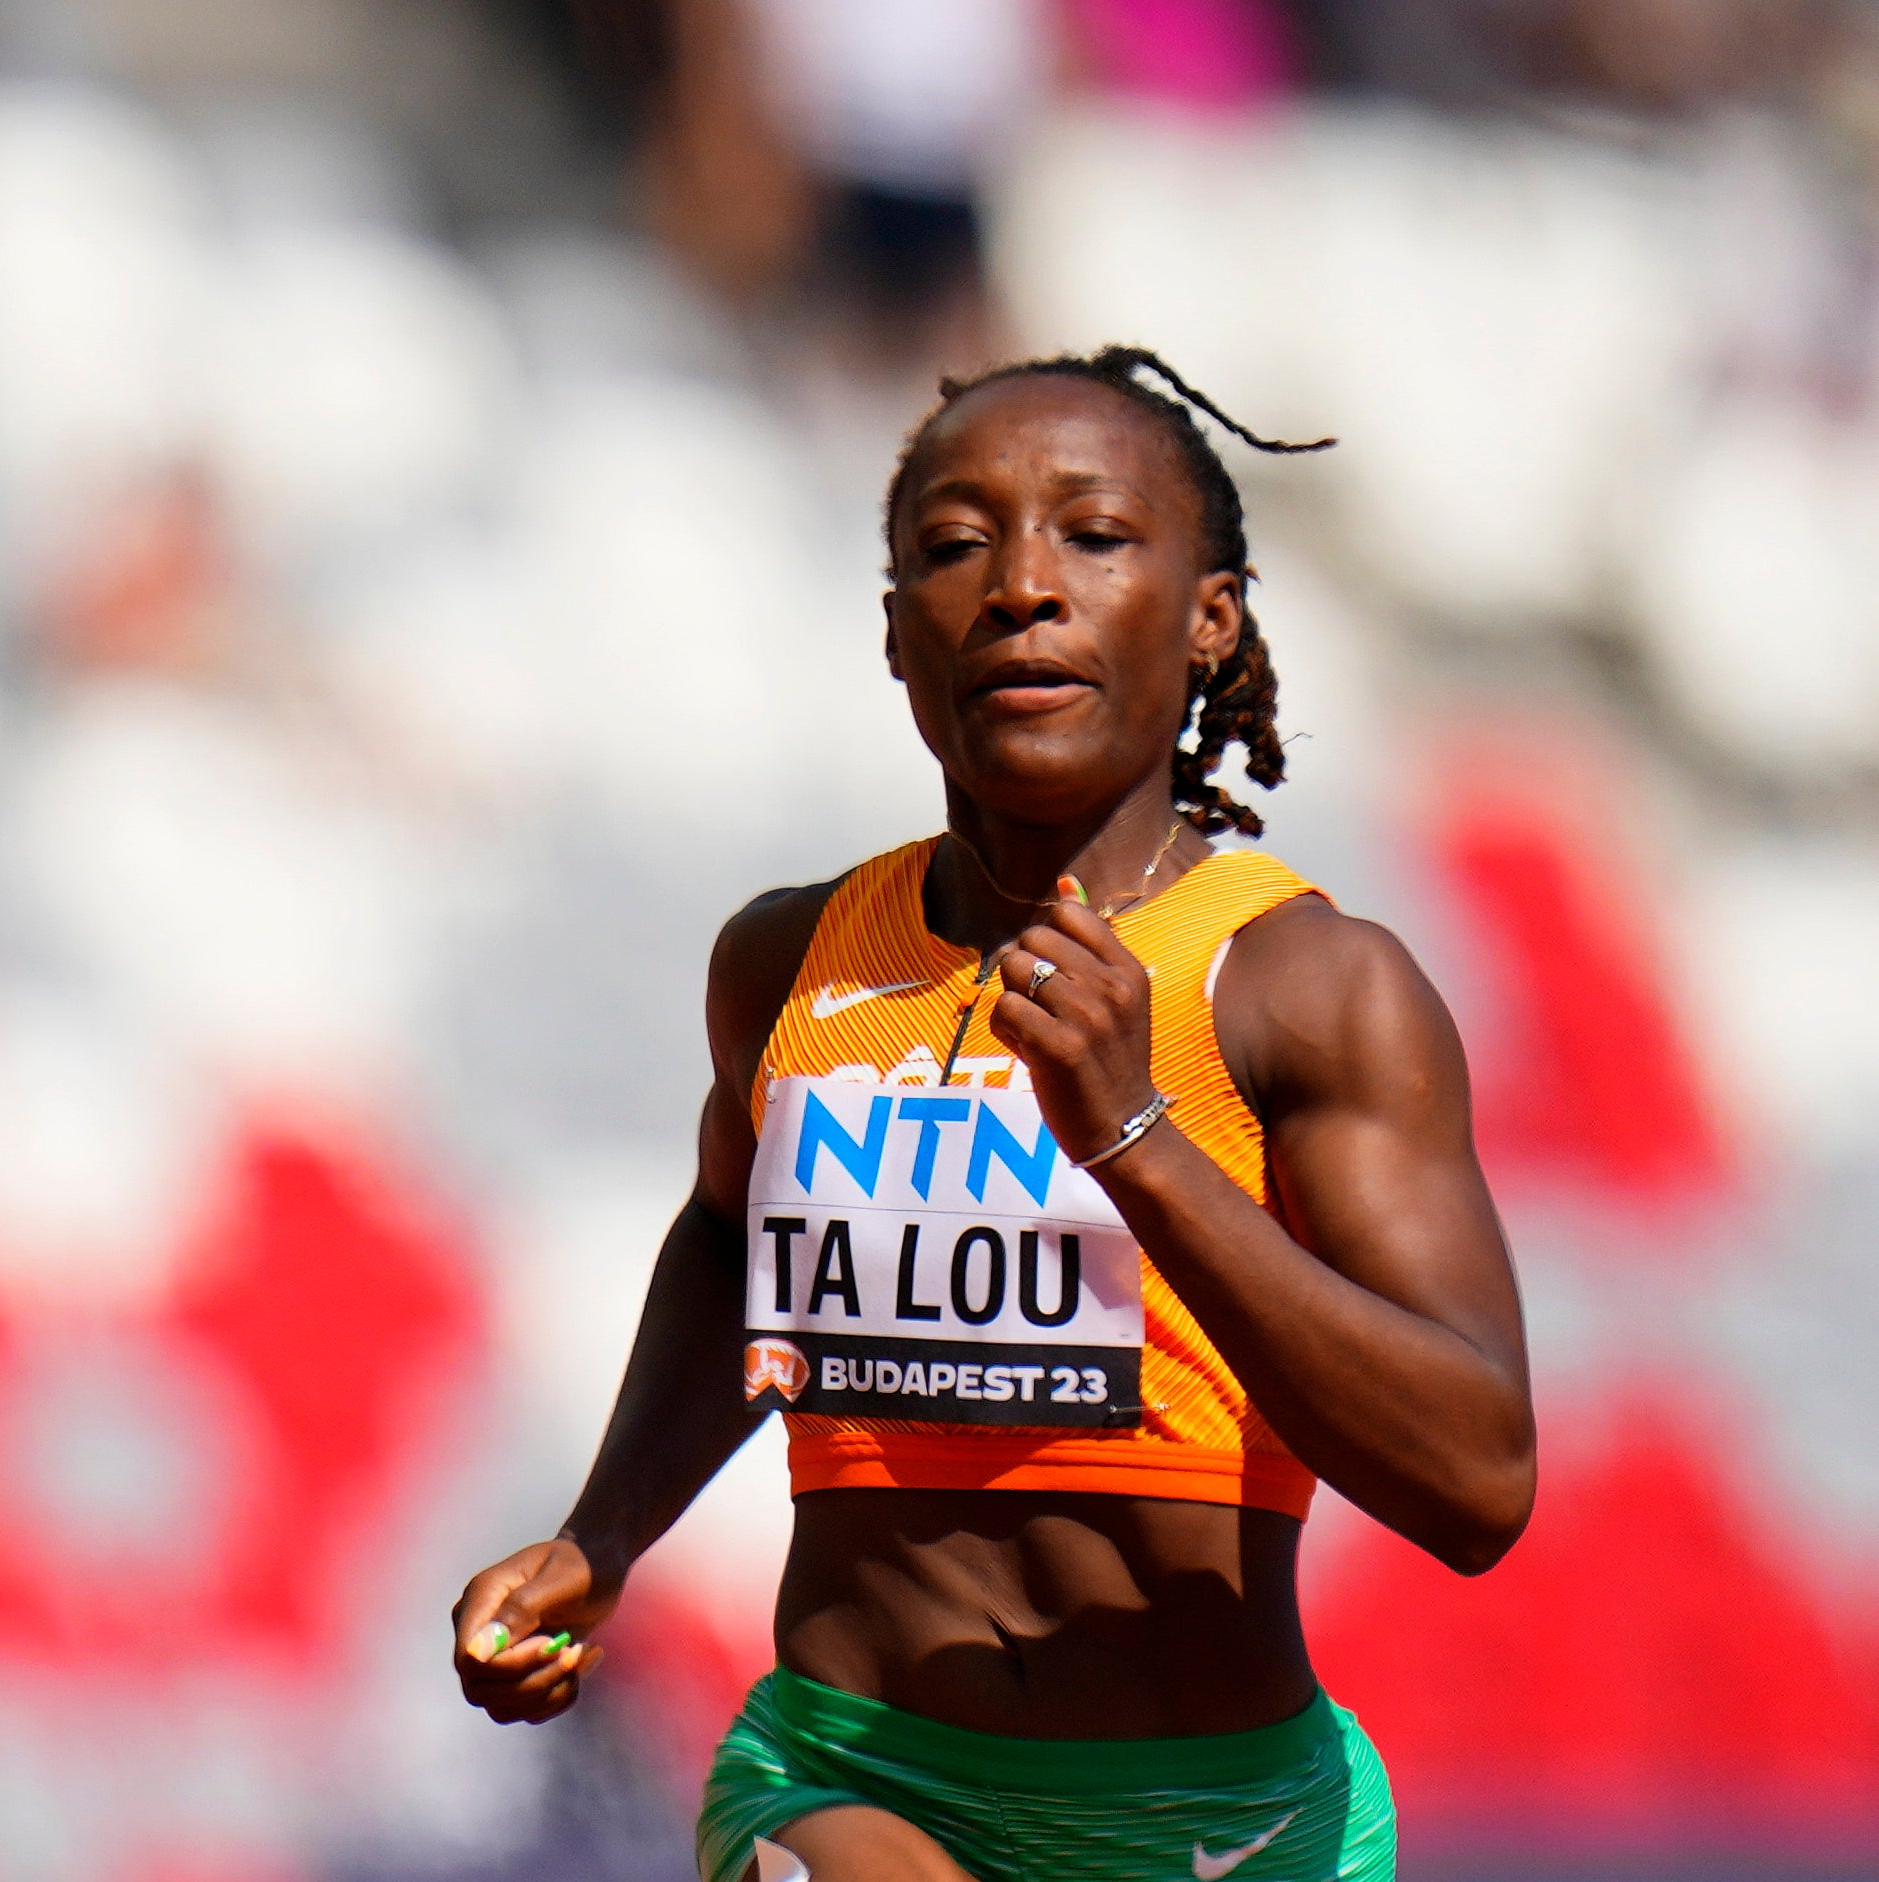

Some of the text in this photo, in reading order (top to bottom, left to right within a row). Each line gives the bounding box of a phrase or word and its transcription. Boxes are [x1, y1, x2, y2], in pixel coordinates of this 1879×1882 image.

[794, 1088, 1058, 1209] NTN
[762, 1216, 1082, 1328] TA LOU
[820, 1357, 1109, 1404] BUDAPEST 23
